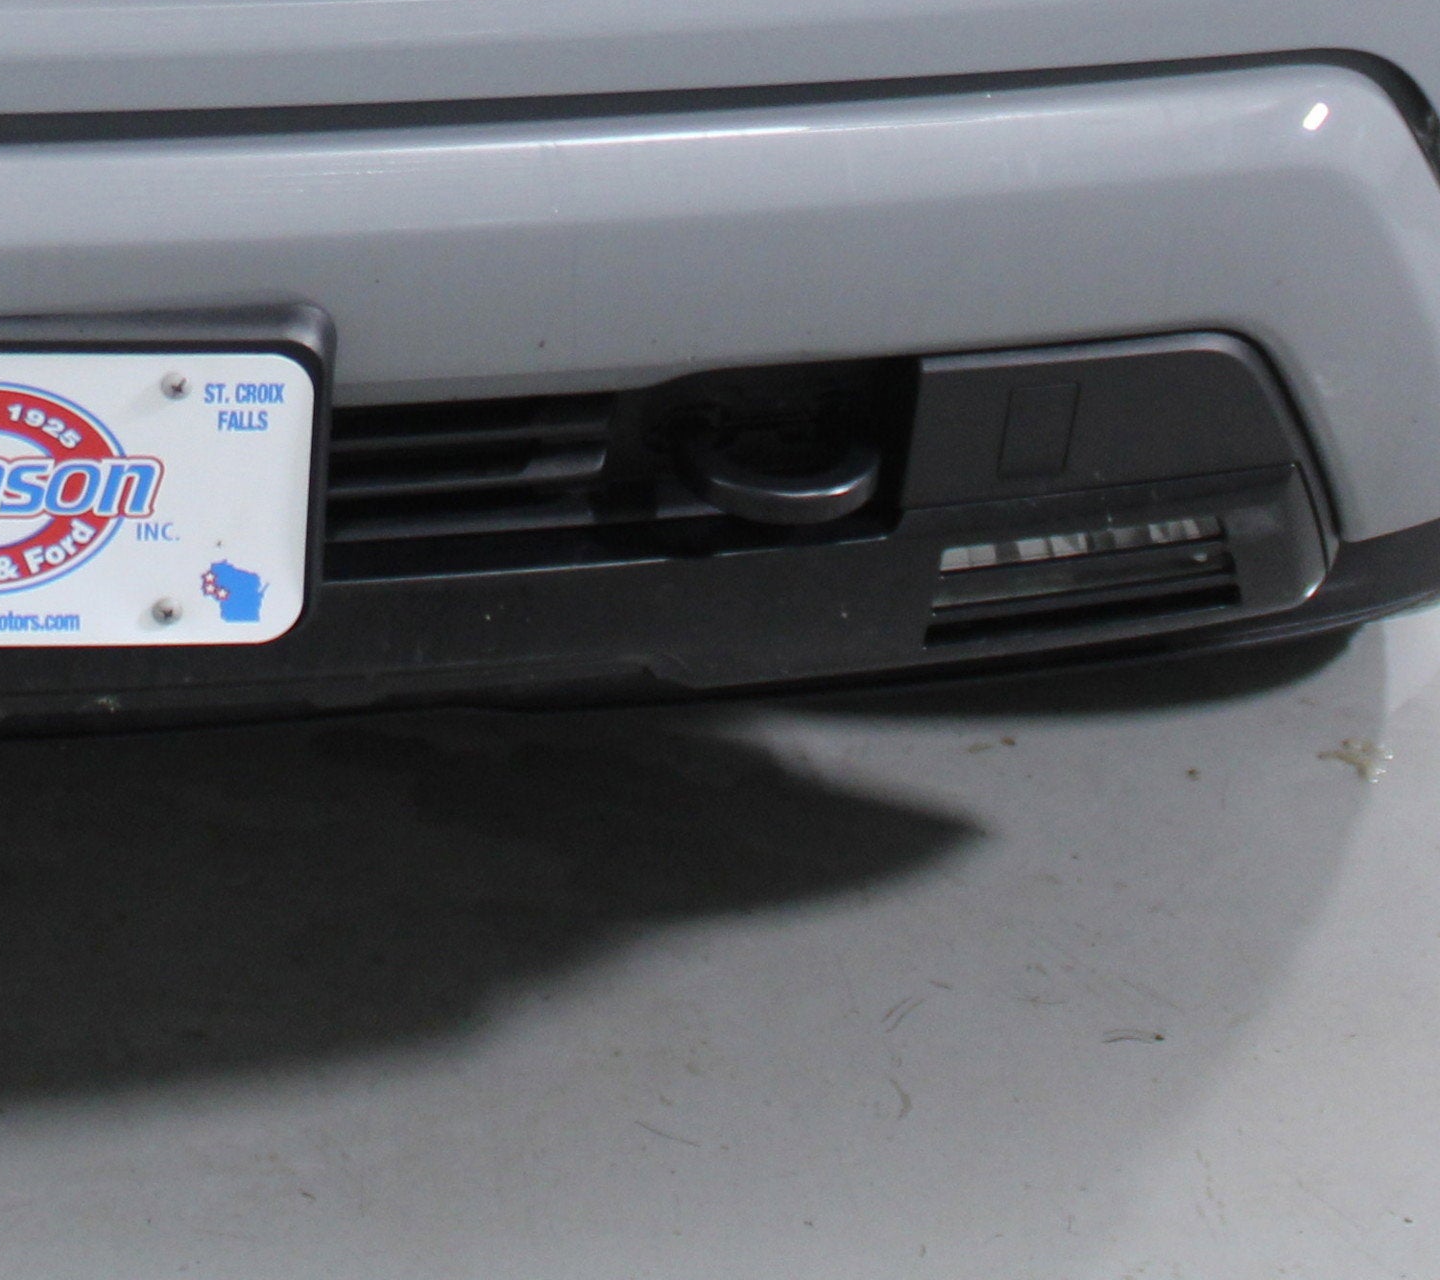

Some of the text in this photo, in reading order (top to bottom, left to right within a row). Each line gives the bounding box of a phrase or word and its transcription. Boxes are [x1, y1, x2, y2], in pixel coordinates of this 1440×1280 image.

[203, 383, 285, 404] ST. CROIX
[7, 403, 82, 449] 1925
[217, 410, 269, 432] FALLS
[135, 522, 181, 542] INC.
[23, 518, 97, 576] Ford
